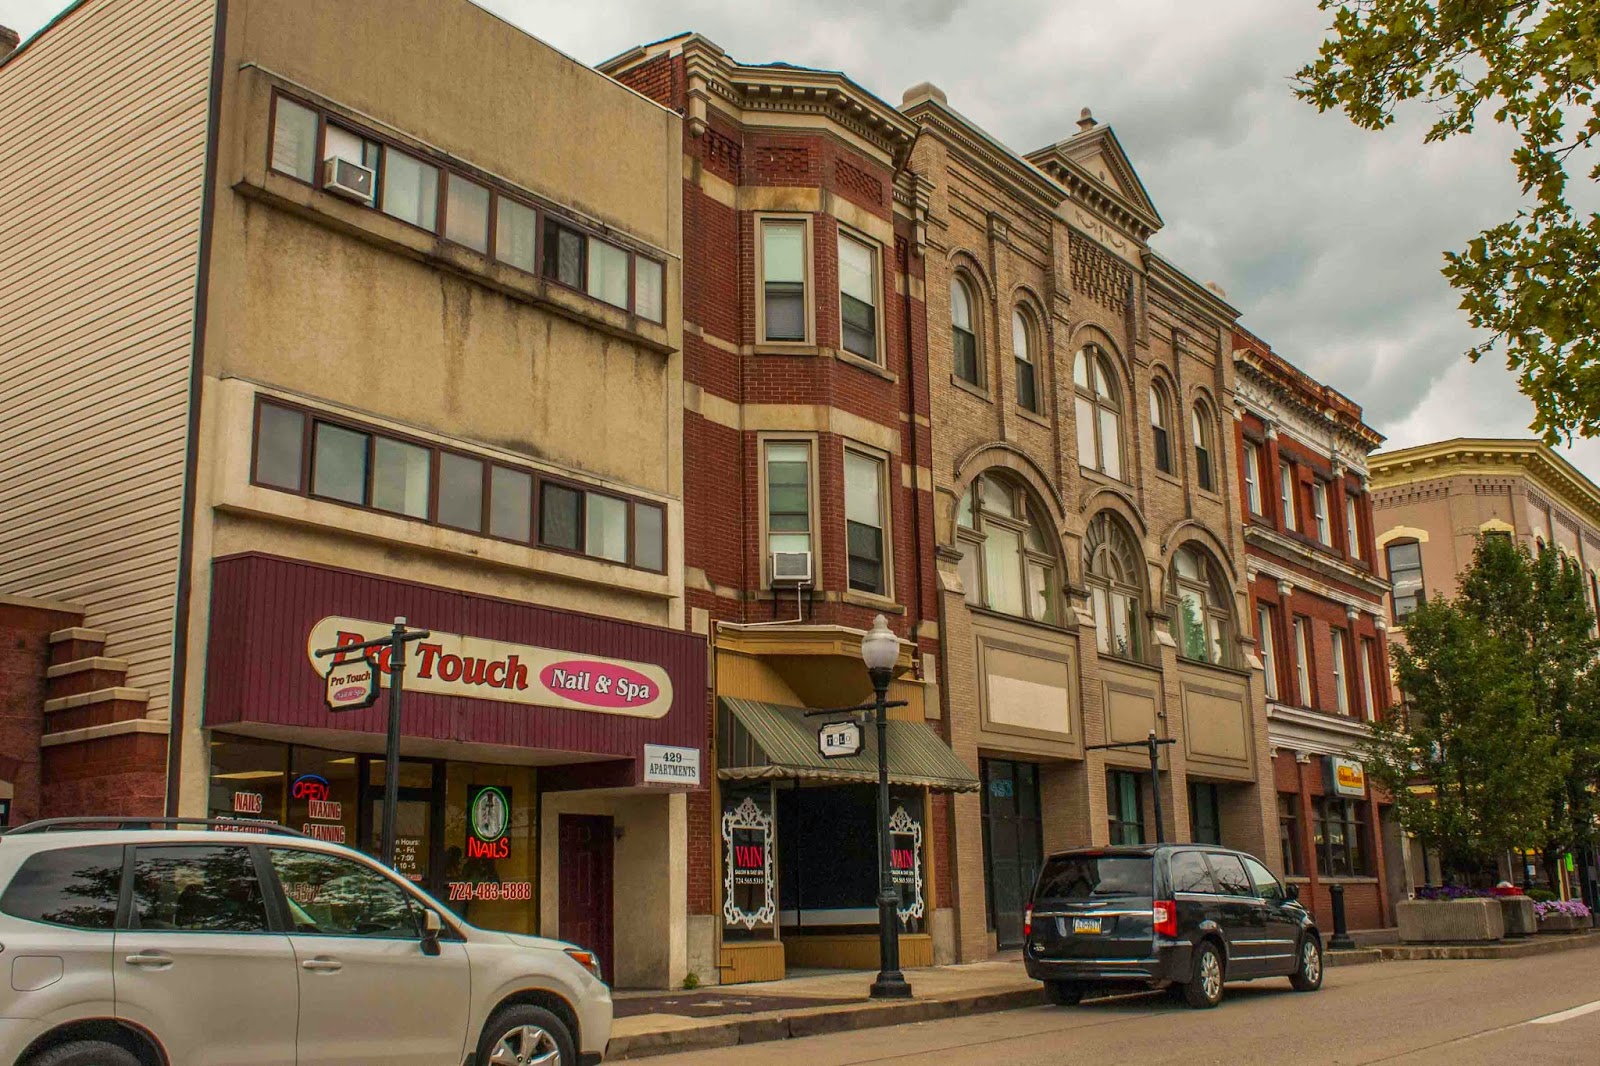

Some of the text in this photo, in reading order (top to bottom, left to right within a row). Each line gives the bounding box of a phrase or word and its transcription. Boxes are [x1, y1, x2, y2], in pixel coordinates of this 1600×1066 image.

[415, 642, 529, 691] Touch
[330, 671, 370, 687] Pro Touch
[551, 668, 651, 702] Nail & Spa
[662, 752, 683, 763] 429
[649, 763, 696, 778] APARTMENTS
[292, 781, 330, 801] OPEN
[234, 791, 263, 814] NAILS
[308, 800, 342, 821] WAXING
[302, 823, 346, 843] & TANNING
[467, 836, 509, 859] NAILS
[735, 845, 764, 868] VAIN
[891, 849, 914, 868] VAIN
[448, 881, 532, 901] 724-483-5888
